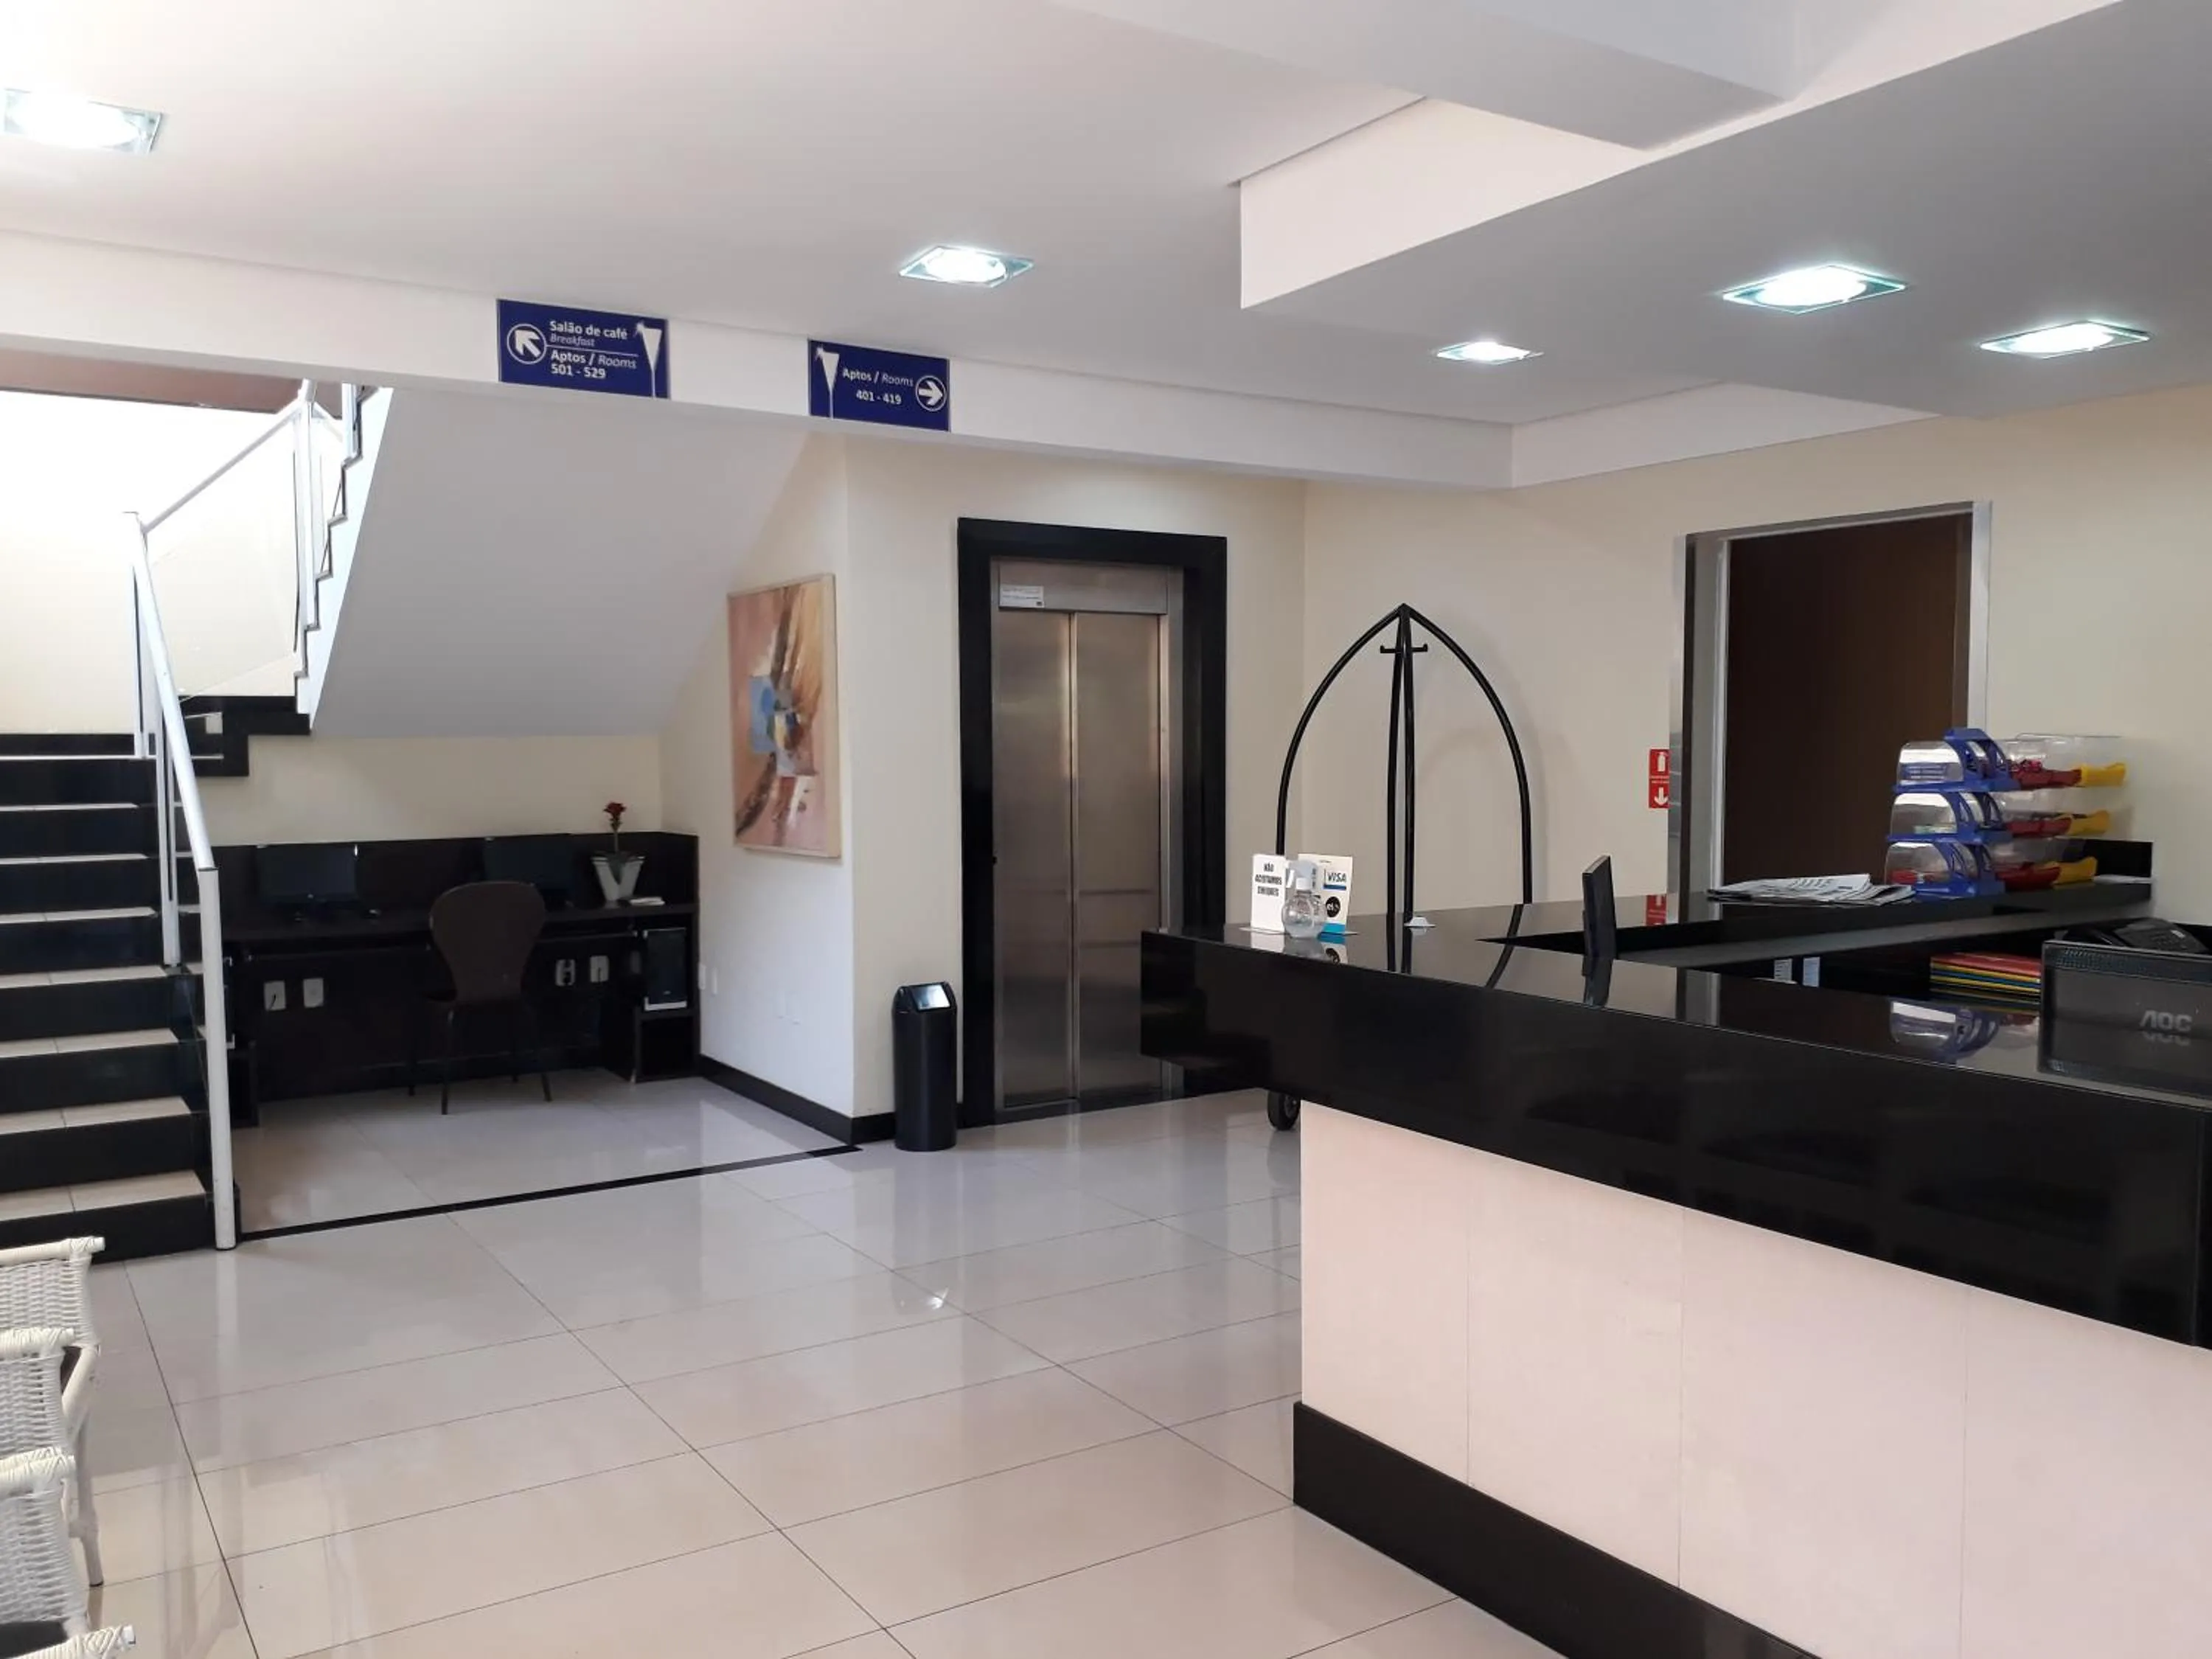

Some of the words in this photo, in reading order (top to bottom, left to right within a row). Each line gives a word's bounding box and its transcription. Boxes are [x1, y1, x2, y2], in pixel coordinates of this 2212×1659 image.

[549, 320, 582, 334] Salão
[586, 324, 601, 337] de
[603, 326, 627, 340] café
[550, 335, 595, 347] Breakfast
[551, 350, 586, 364] Aptos
[588, 354, 595, 366] /
[599, 355, 637, 369] Rooms
[552, 364, 574, 376] 501
[584, 367, 606, 379] 529
[843, 369, 872, 382] Aptos
[874, 371, 880, 384] /
[882, 373, 914, 387] Rooms
[856, 389, 874, 402] 401
[883, 393, 902, 405] 419
[1328, 872, 1346, 883] VISA
[2140, 1009, 2192, 1032] AOC
